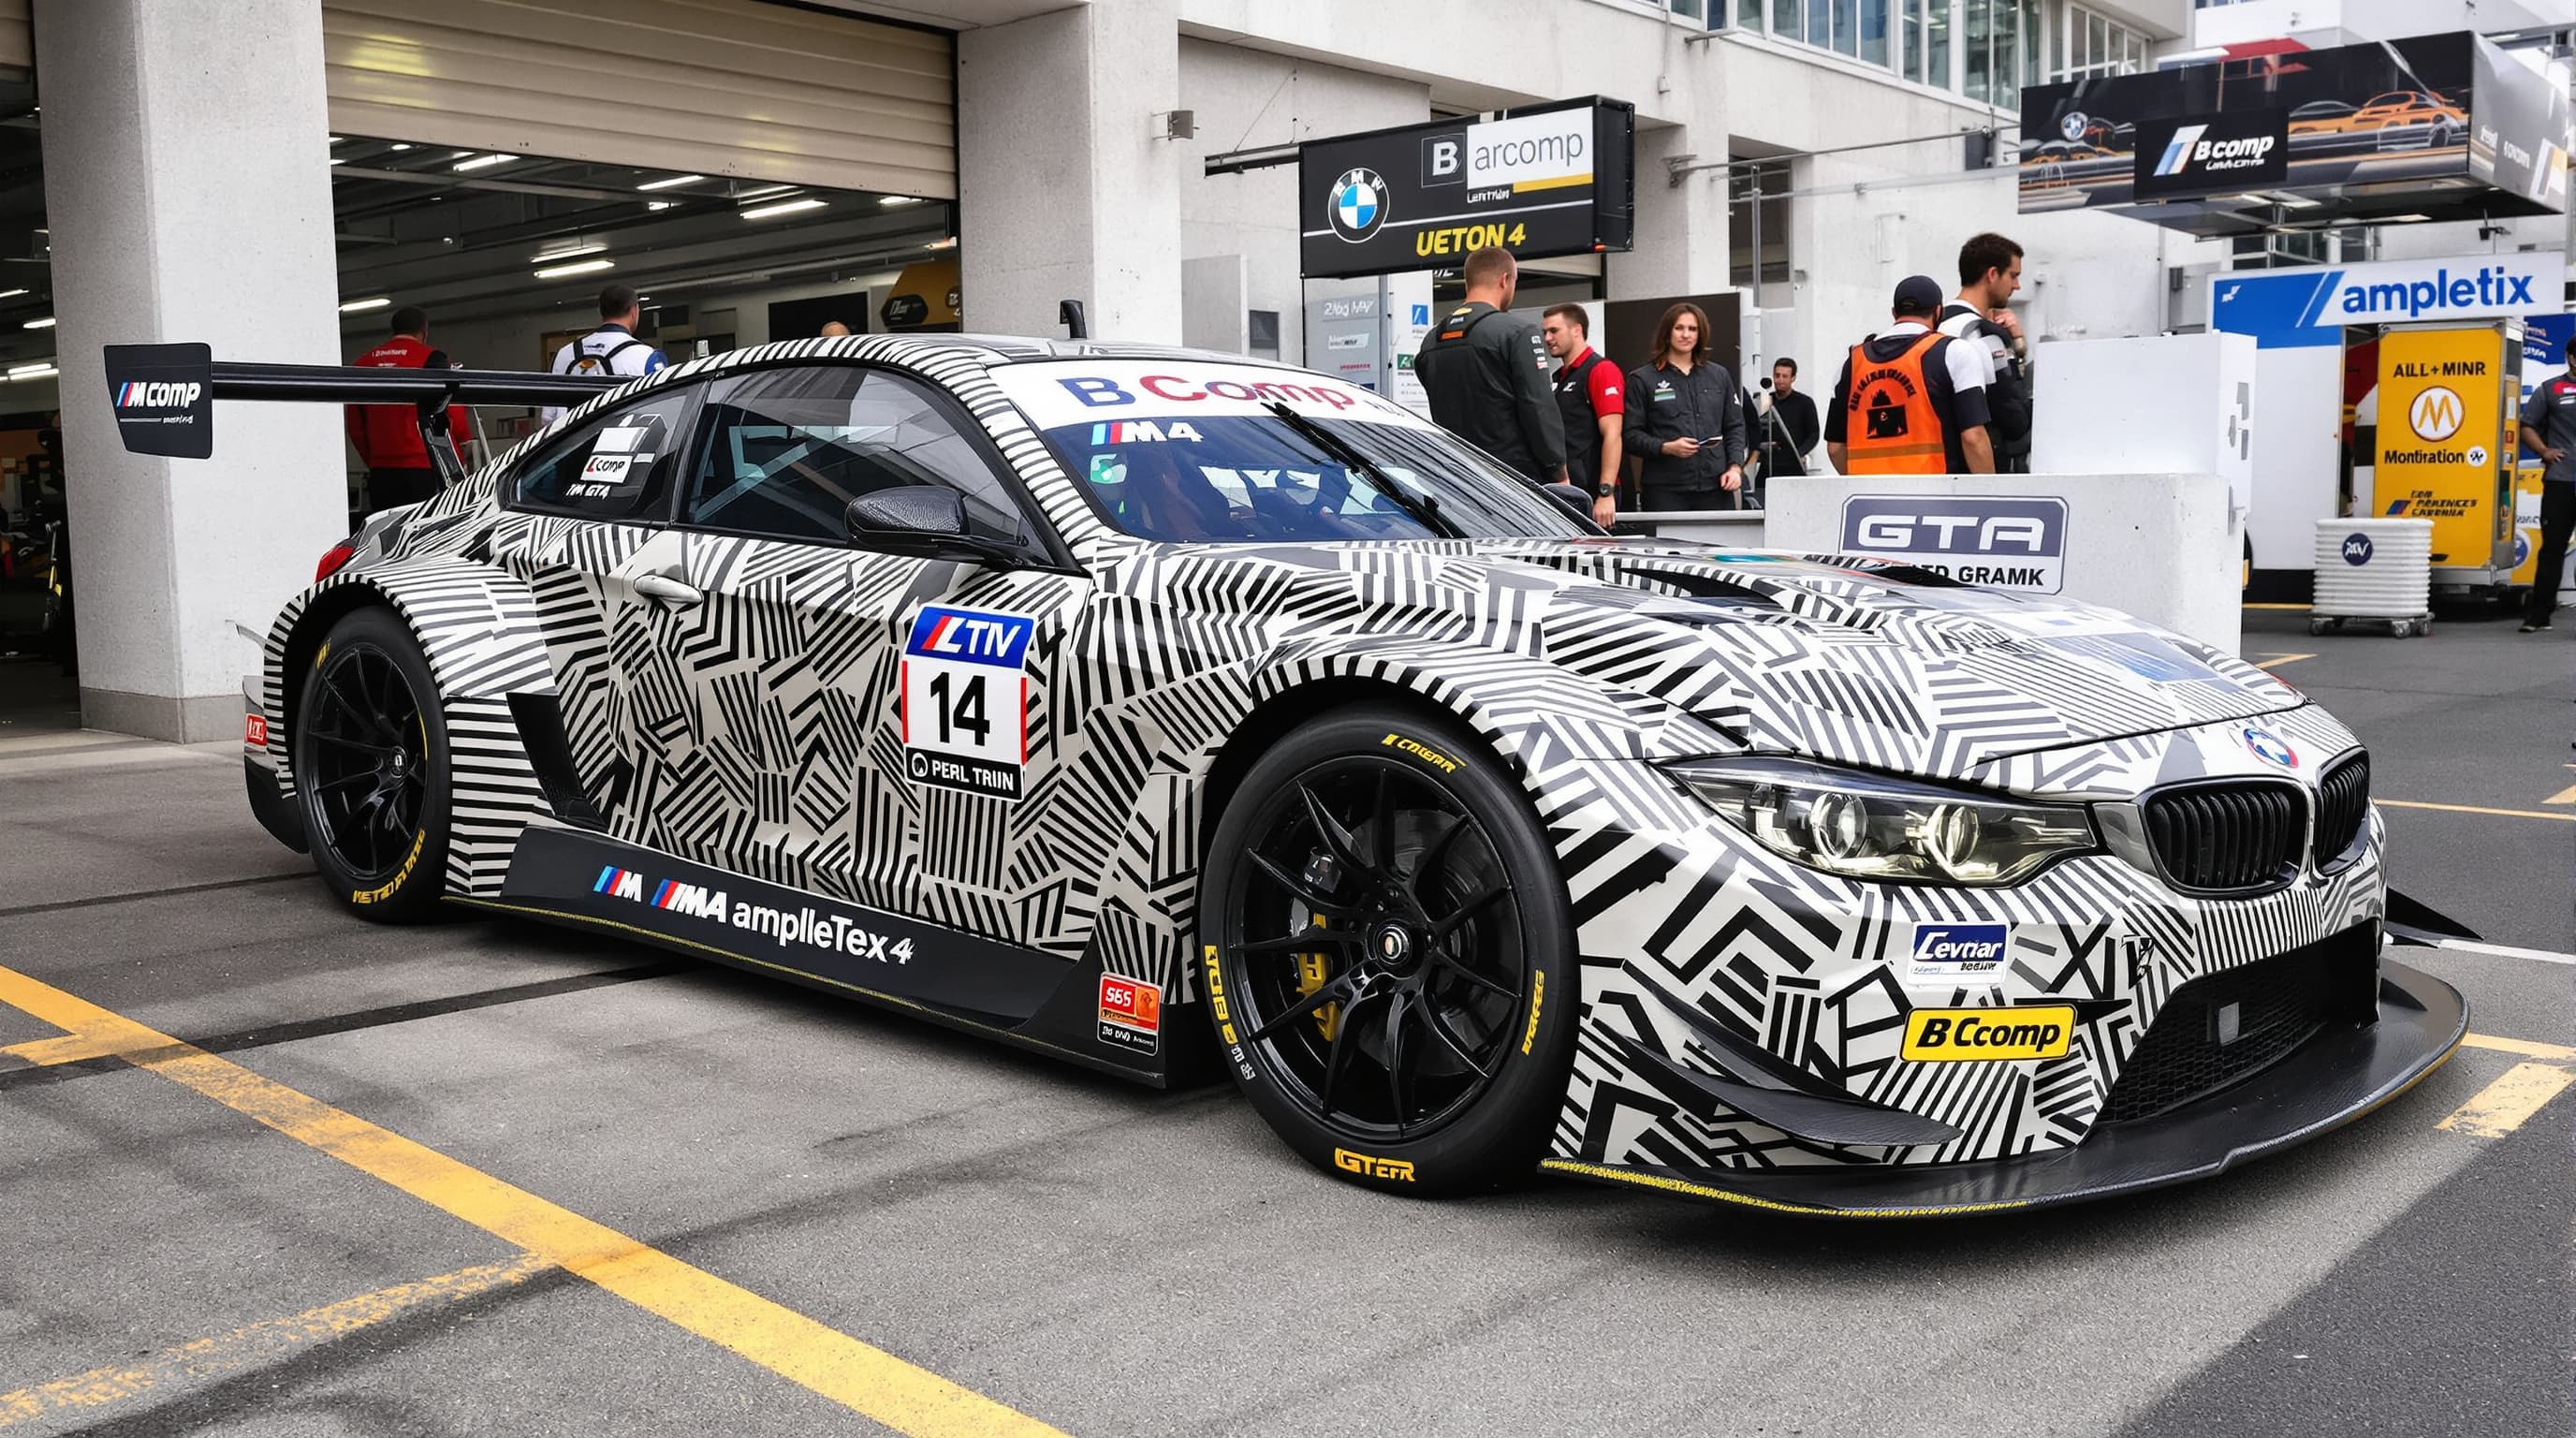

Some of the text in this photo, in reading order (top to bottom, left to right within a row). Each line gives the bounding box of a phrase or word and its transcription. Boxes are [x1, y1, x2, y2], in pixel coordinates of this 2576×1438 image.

[1474, 132, 1584, 170] arcomp
[1416, 223, 1527, 257] UETON 4
[2342, 266, 2535, 317] ampletix
[1056, 377, 1136, 407] B
[1139, 374, 1355, 410] Comp
[2417, 395, 2456, 432] M
[1120, 421, 1205, 444] M4
[1857, 515, 2045, 552] GTA
[1958, 565, 2046, 586] GRAMK
[930, 671, 990, 747] 14
[932, 759, 970, 783] PERL
